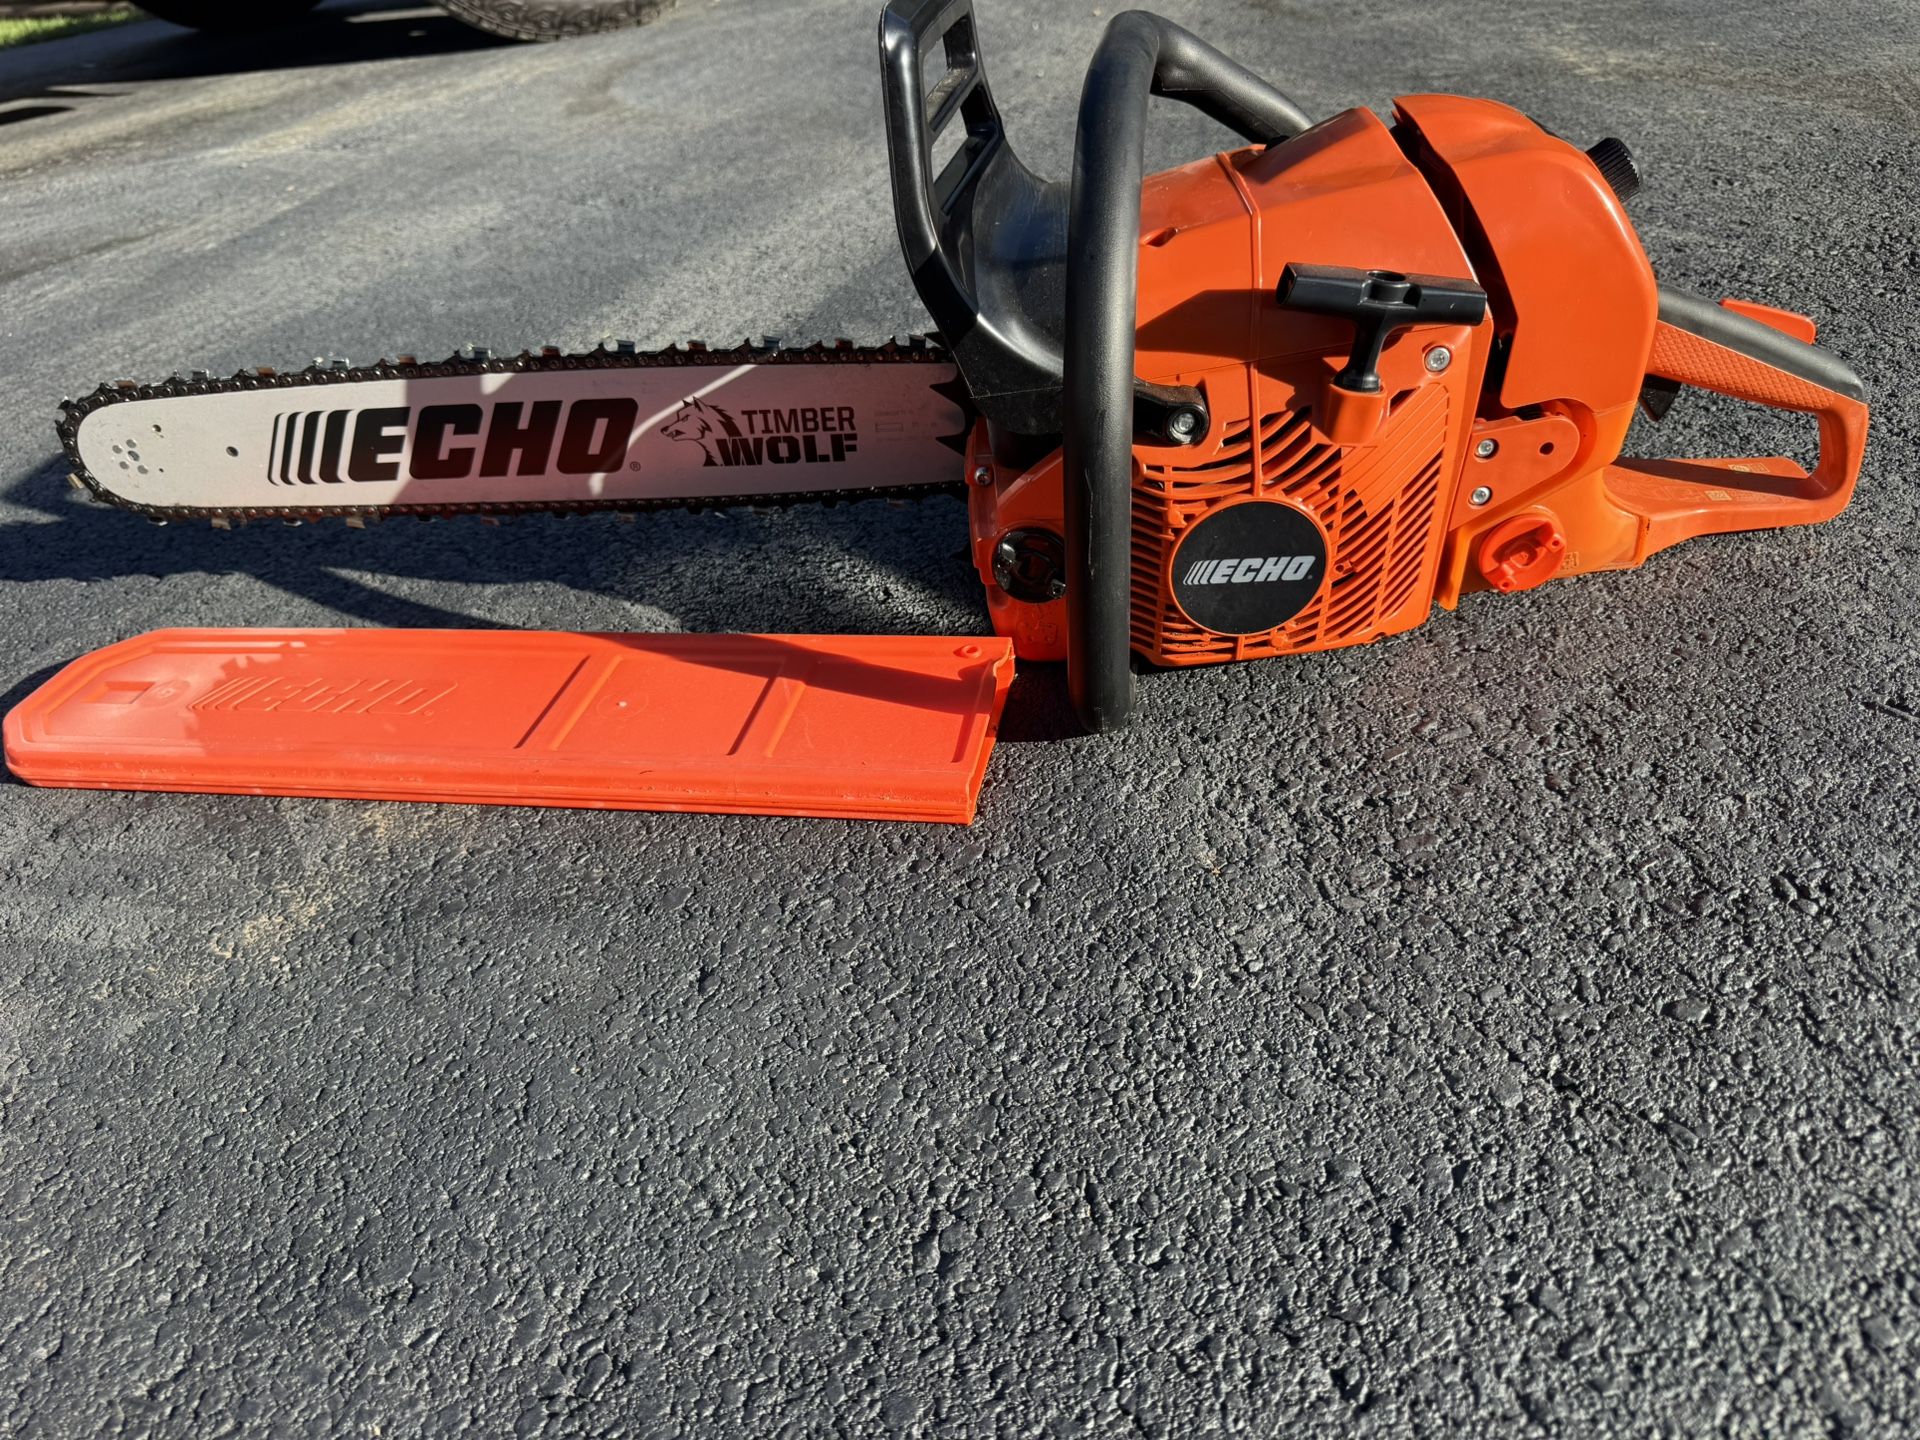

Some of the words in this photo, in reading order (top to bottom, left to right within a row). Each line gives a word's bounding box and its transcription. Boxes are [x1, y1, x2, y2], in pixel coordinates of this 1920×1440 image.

[741, 406, 856, 435] TIMBER
[347, 398, 639, 483] ECHO
[715, 433, 858, 467] WOLF
[1209, 555, 1317, 585] ECHO
[230, 676, 459, 716] ECHO
